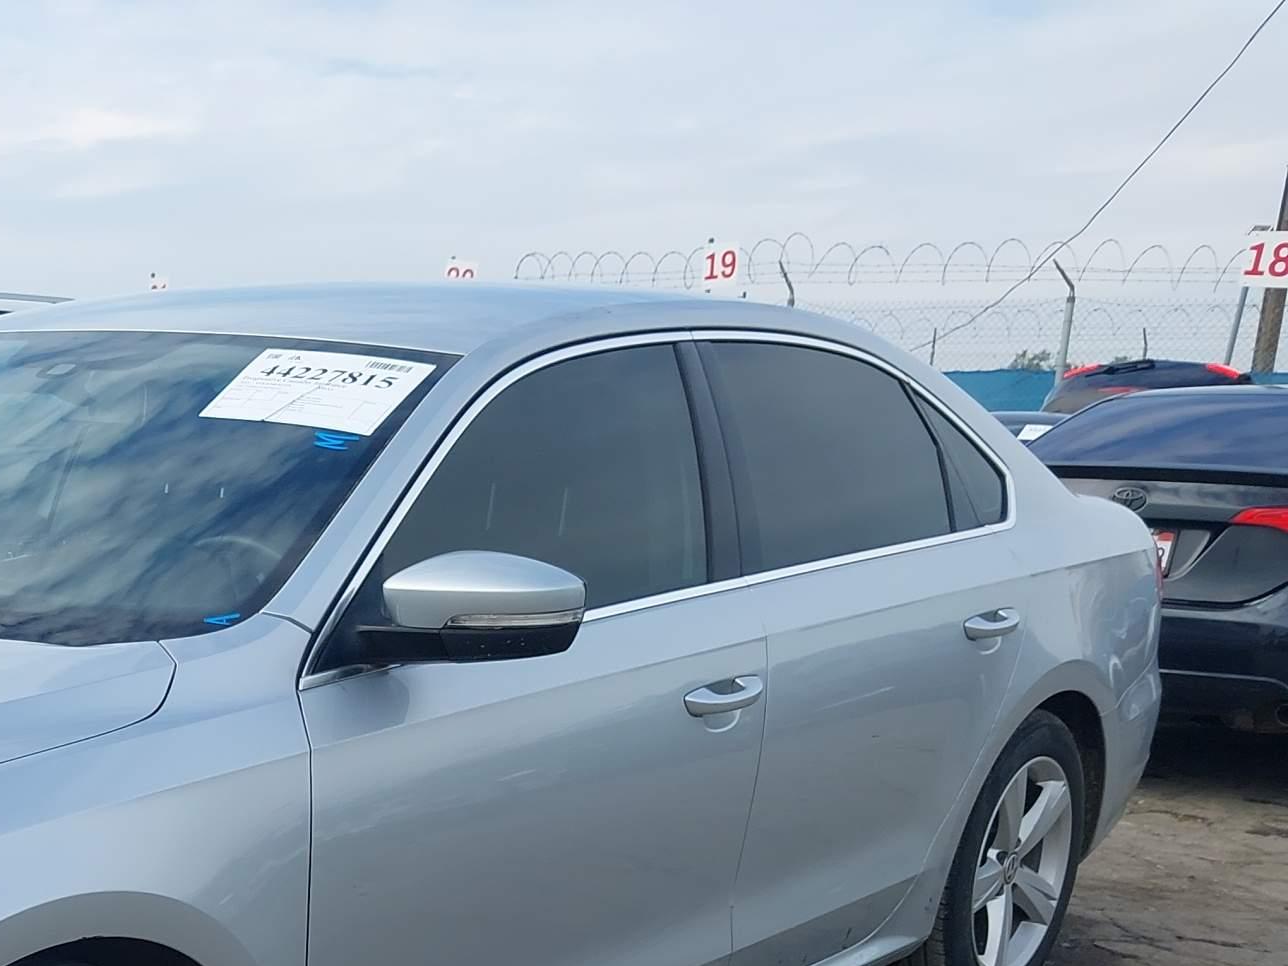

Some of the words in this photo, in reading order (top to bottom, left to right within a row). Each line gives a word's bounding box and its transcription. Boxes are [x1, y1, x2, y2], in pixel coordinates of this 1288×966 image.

[704, 250, 736, 280] 19
[1243, 242, 1288, 277] 18
[259, 364, 399, 389] 44227815
